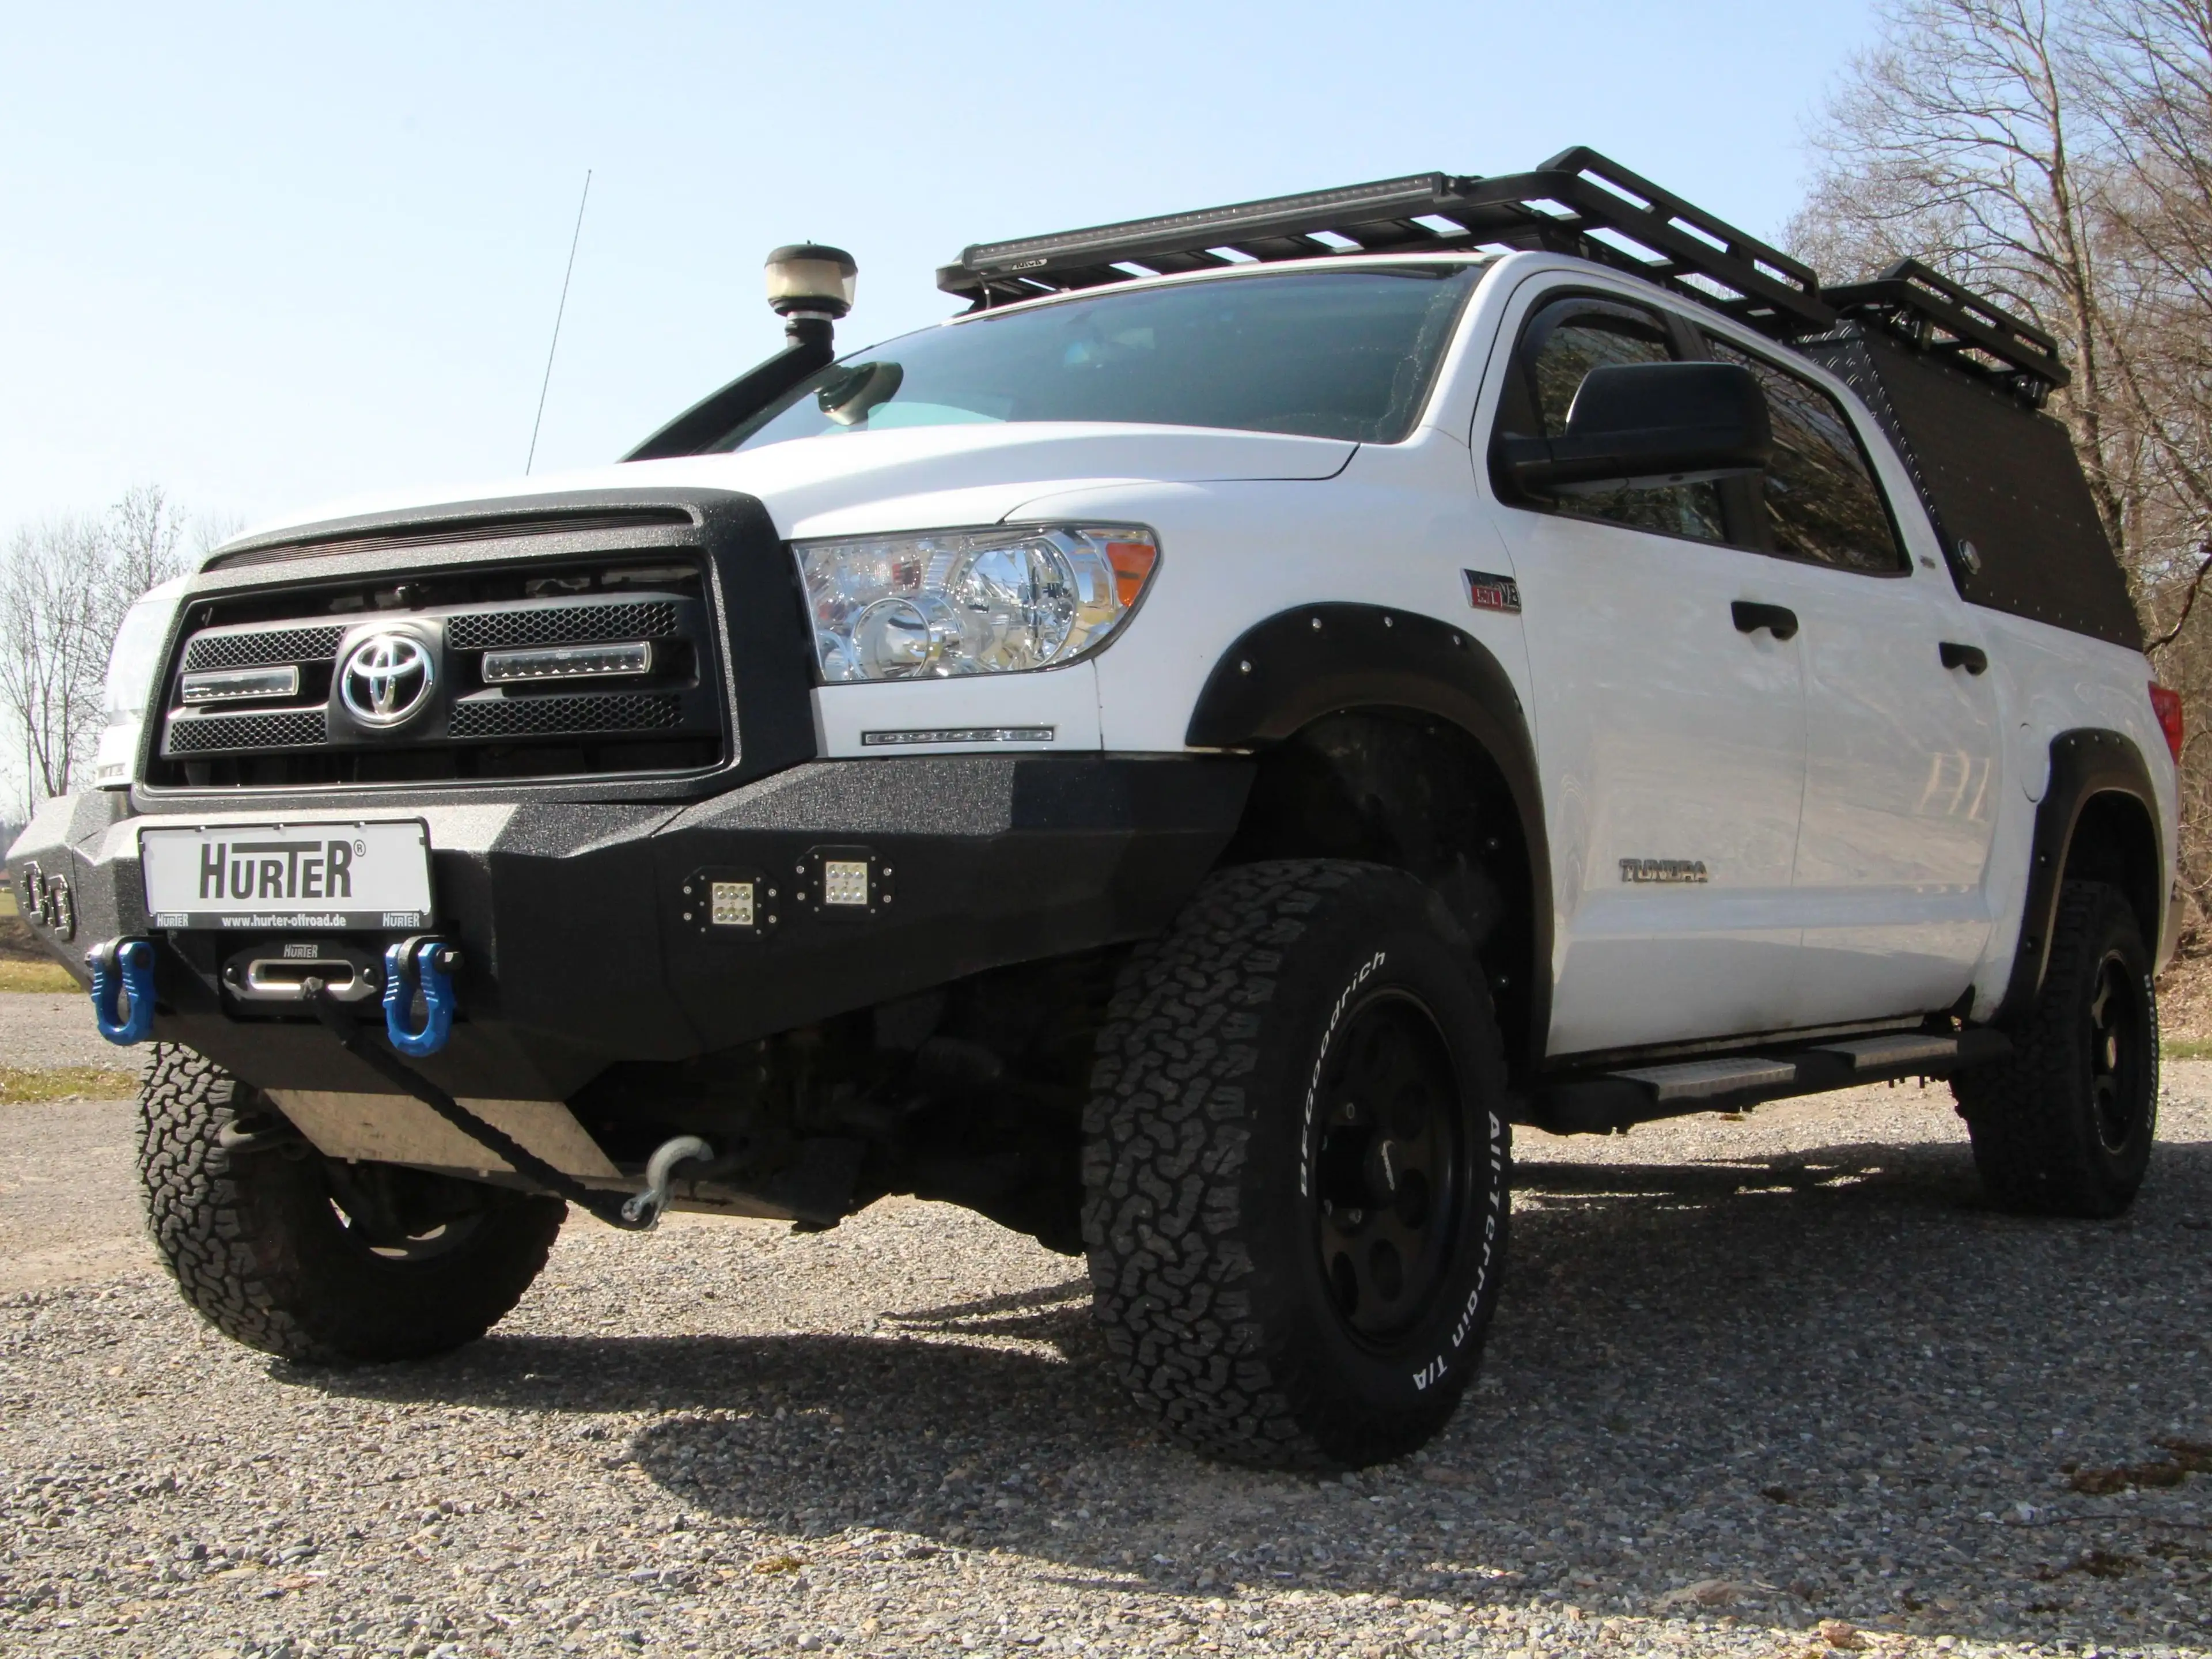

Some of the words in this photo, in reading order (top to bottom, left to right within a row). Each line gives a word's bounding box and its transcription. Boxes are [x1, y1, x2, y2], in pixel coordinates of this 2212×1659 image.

[1498, 581, 1521, 607] V8
[1619, 858, 1708, 882] TUNDRA
[156, 913, 189, 927] HURTER
[221, 914, 347, 927] www.hurter-offroad.de
[382, 912, 420, 927] HURTER
[283, 944, 318, 958] HURTER
[1300, 951, 1385, 1197] BFGoodrich
[1452, 1110, 1501, 1347] All-Terrain
[1412, 1354, 1448, 1390] T/A
